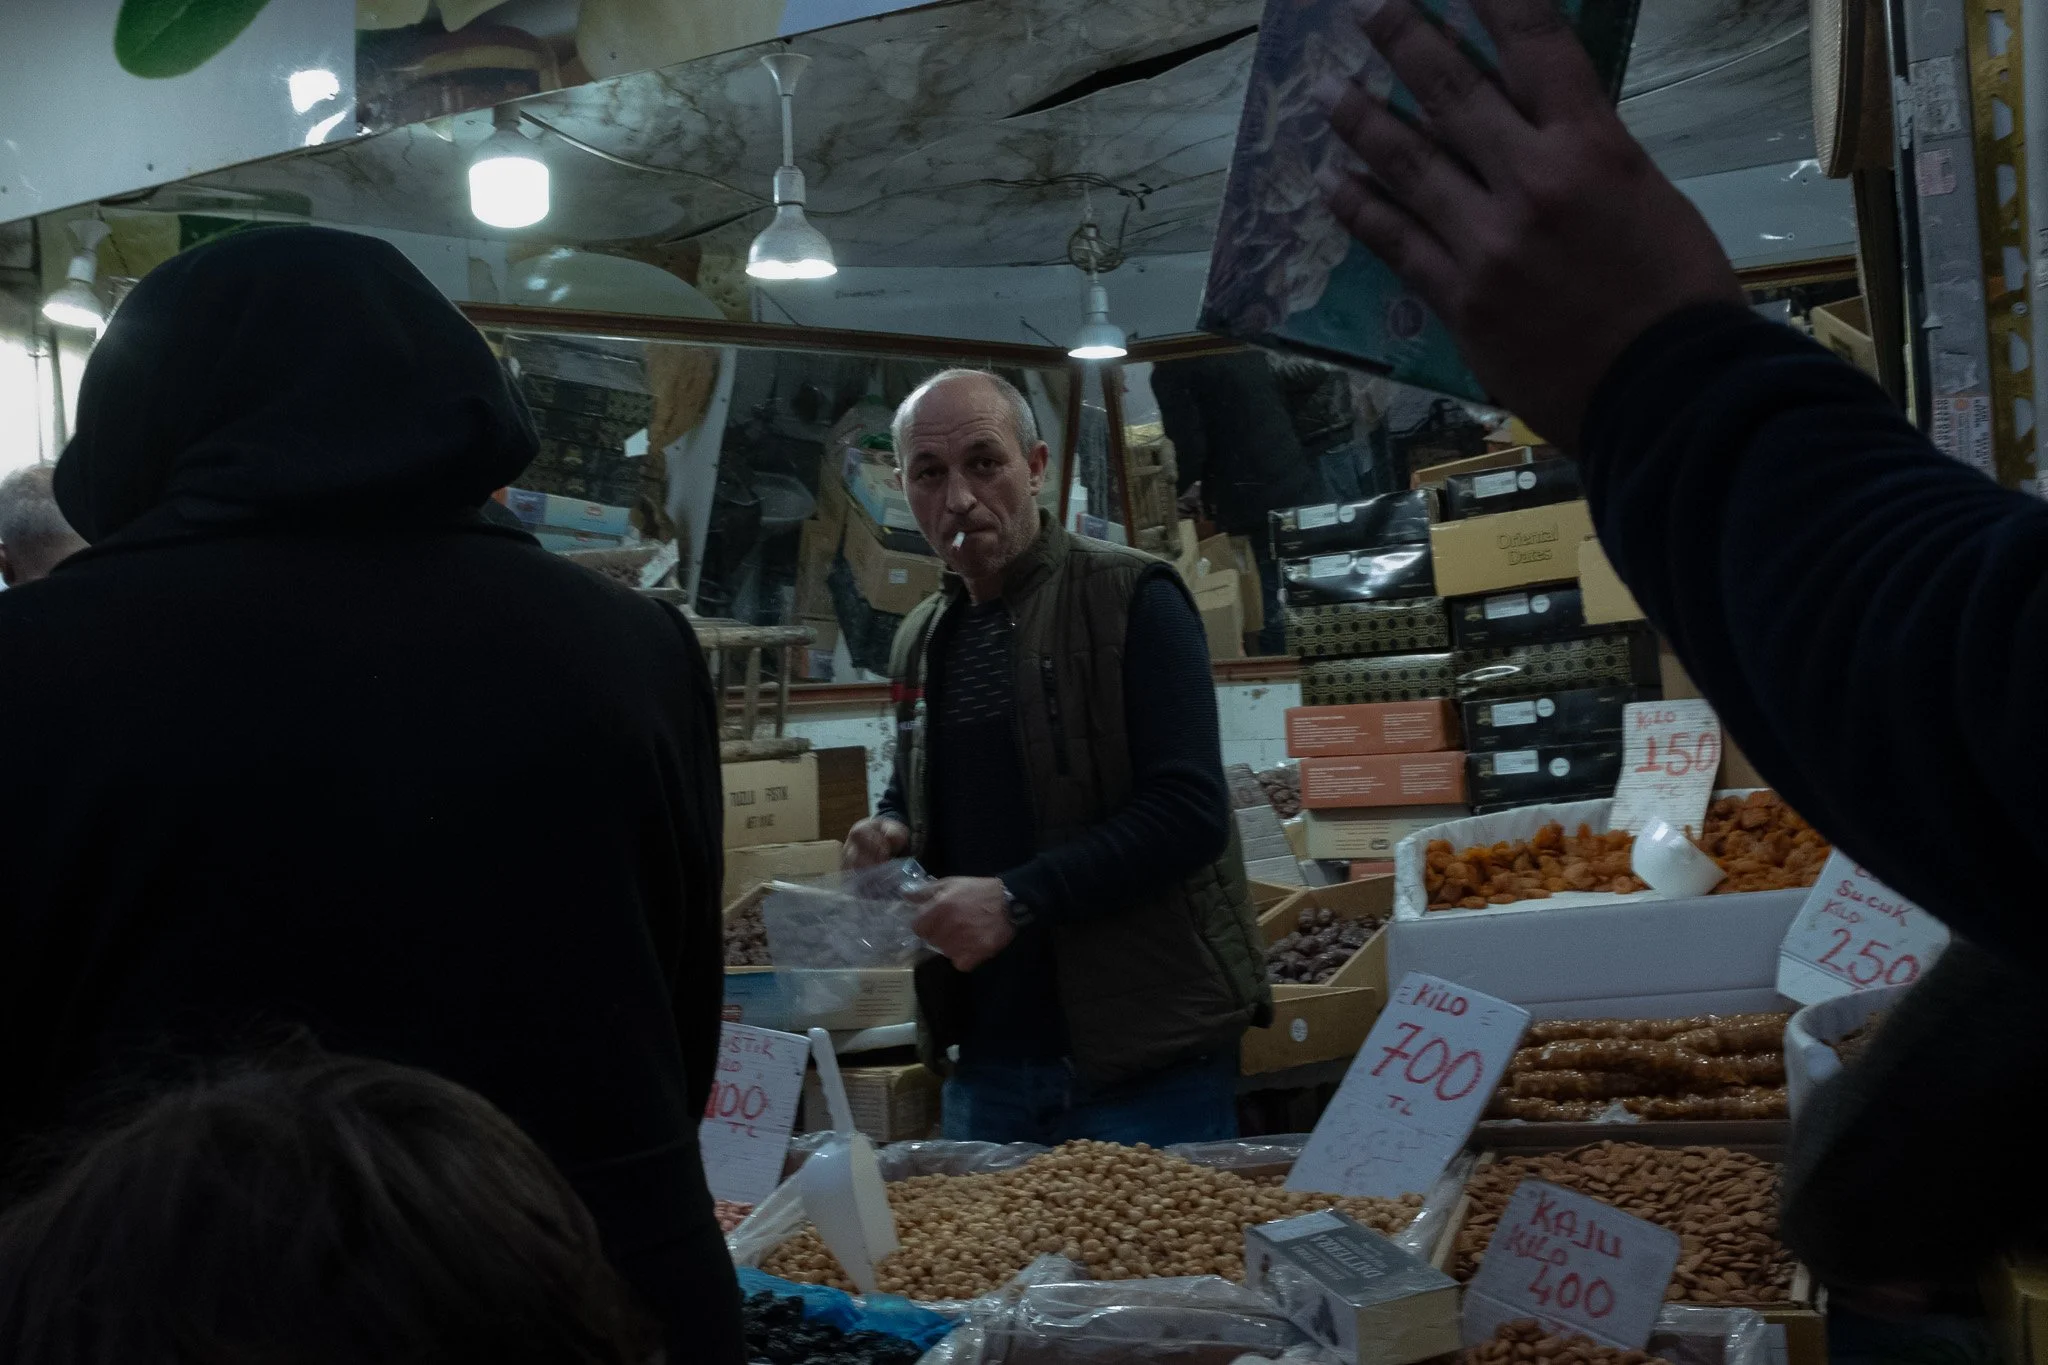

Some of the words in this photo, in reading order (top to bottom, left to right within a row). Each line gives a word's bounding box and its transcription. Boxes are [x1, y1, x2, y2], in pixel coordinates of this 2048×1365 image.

[1498, 524, 1559, 550] Oriental
[1508, 549, 1553, 566] Dates
[1634, 731, 1716, 777] 150
[1816, 928, 1920, 985] 250
[1370, 1021, 1485, 1102] 700
[1387, 1094, 1414, 1117] TL
[726, 1121, 760, 1138] TL
[1531, 1197, 1623, 1260] KAJU
[1528, 1264, 1615, 1319] 400
